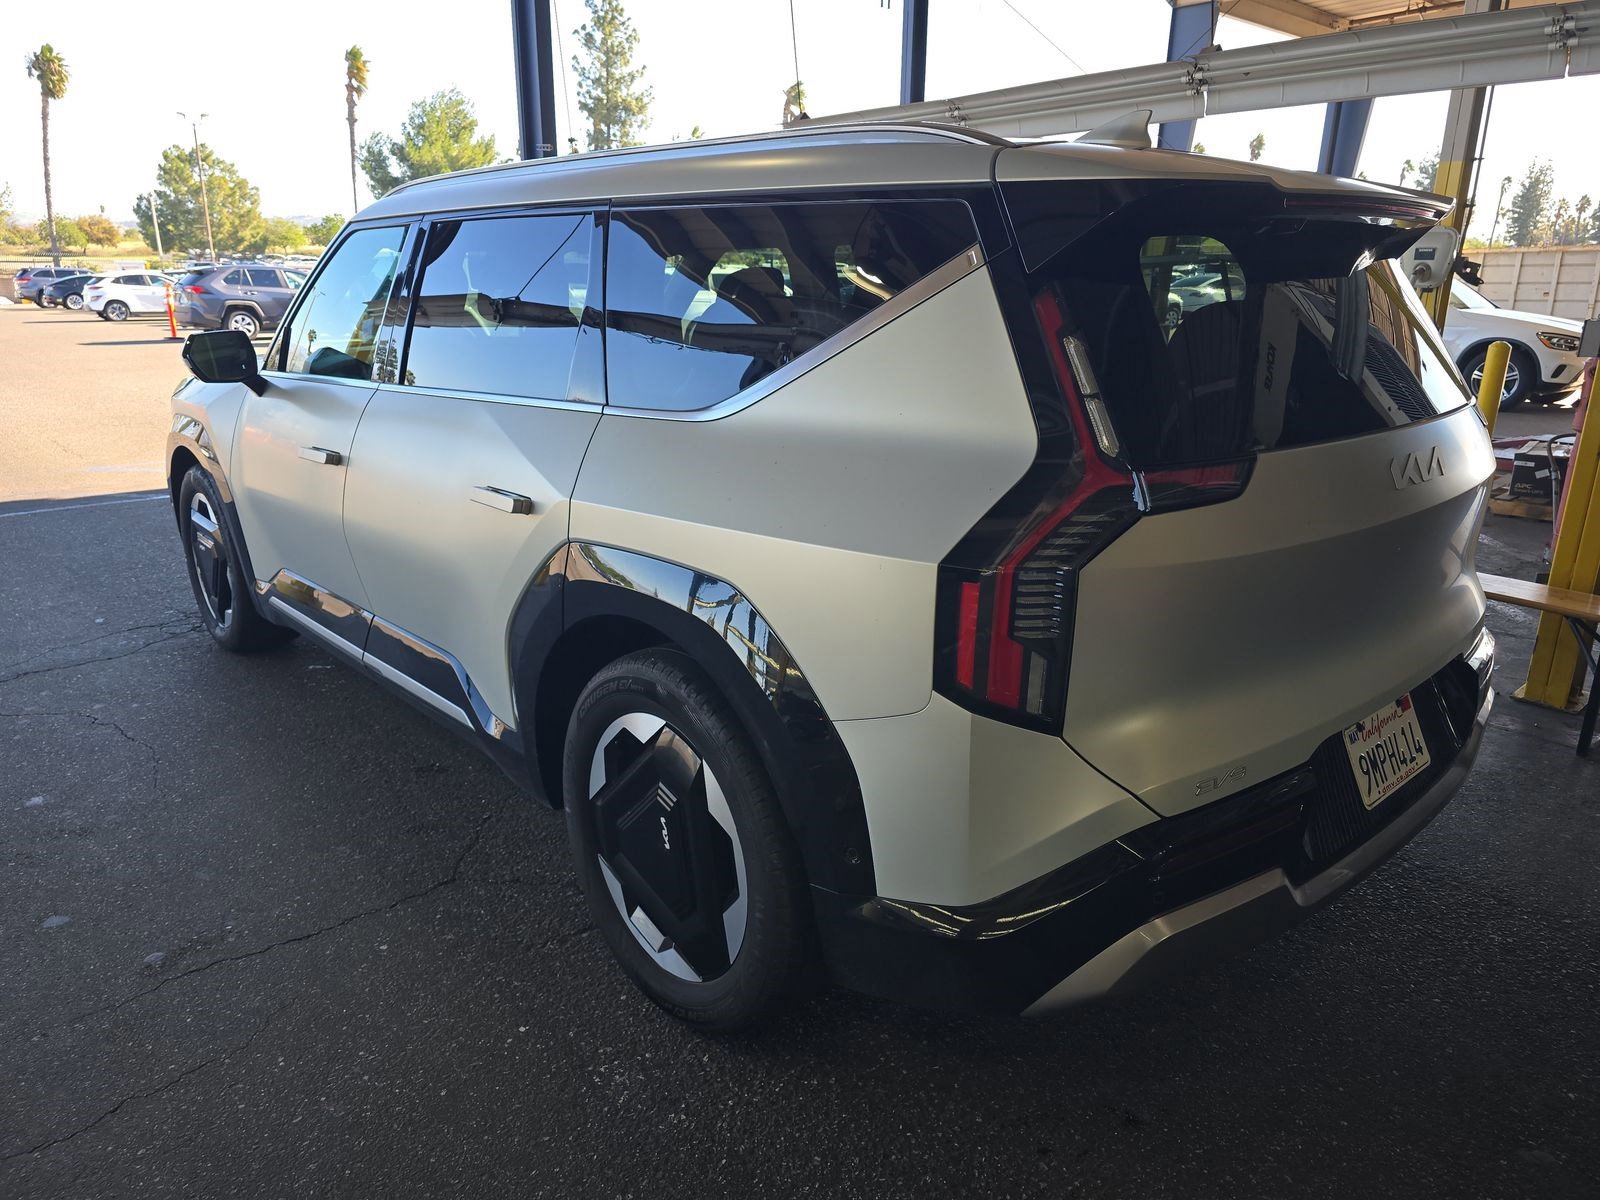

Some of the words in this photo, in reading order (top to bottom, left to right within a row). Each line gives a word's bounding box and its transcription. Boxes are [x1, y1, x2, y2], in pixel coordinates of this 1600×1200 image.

[1389, 446, 1443, 490] KIA
[1360, 706, 1403, 742] California
[1358, 721, 1424, 798] 9MPH414
[1195, 767, 1247, 796] EV9
[1382, 766, 1416, 794] dmv.ca.gov
